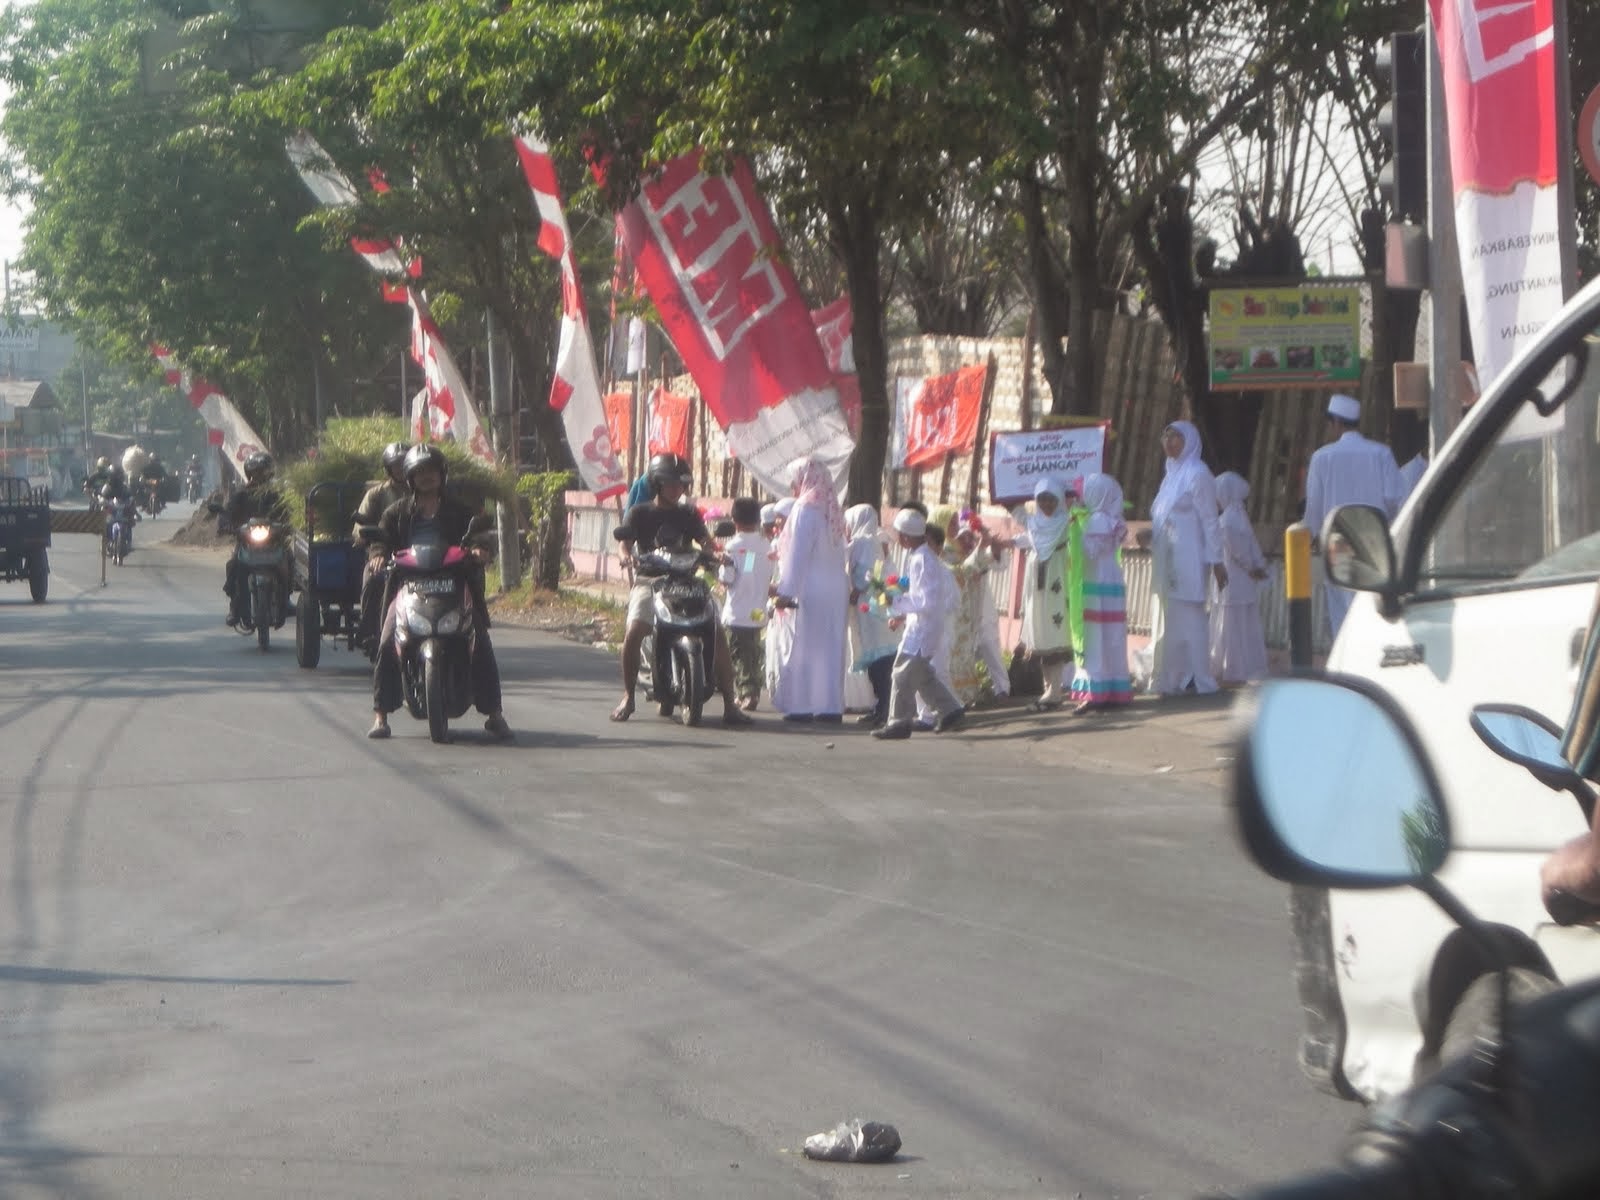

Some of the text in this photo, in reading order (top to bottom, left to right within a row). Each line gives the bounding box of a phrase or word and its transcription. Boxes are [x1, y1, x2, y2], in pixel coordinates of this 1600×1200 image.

[1026, 441, 1074, 453] MAKSIAT
[1065, 450, 1098, 460] dengan
[1017, 460, 1080, 475] SEMANGAT
